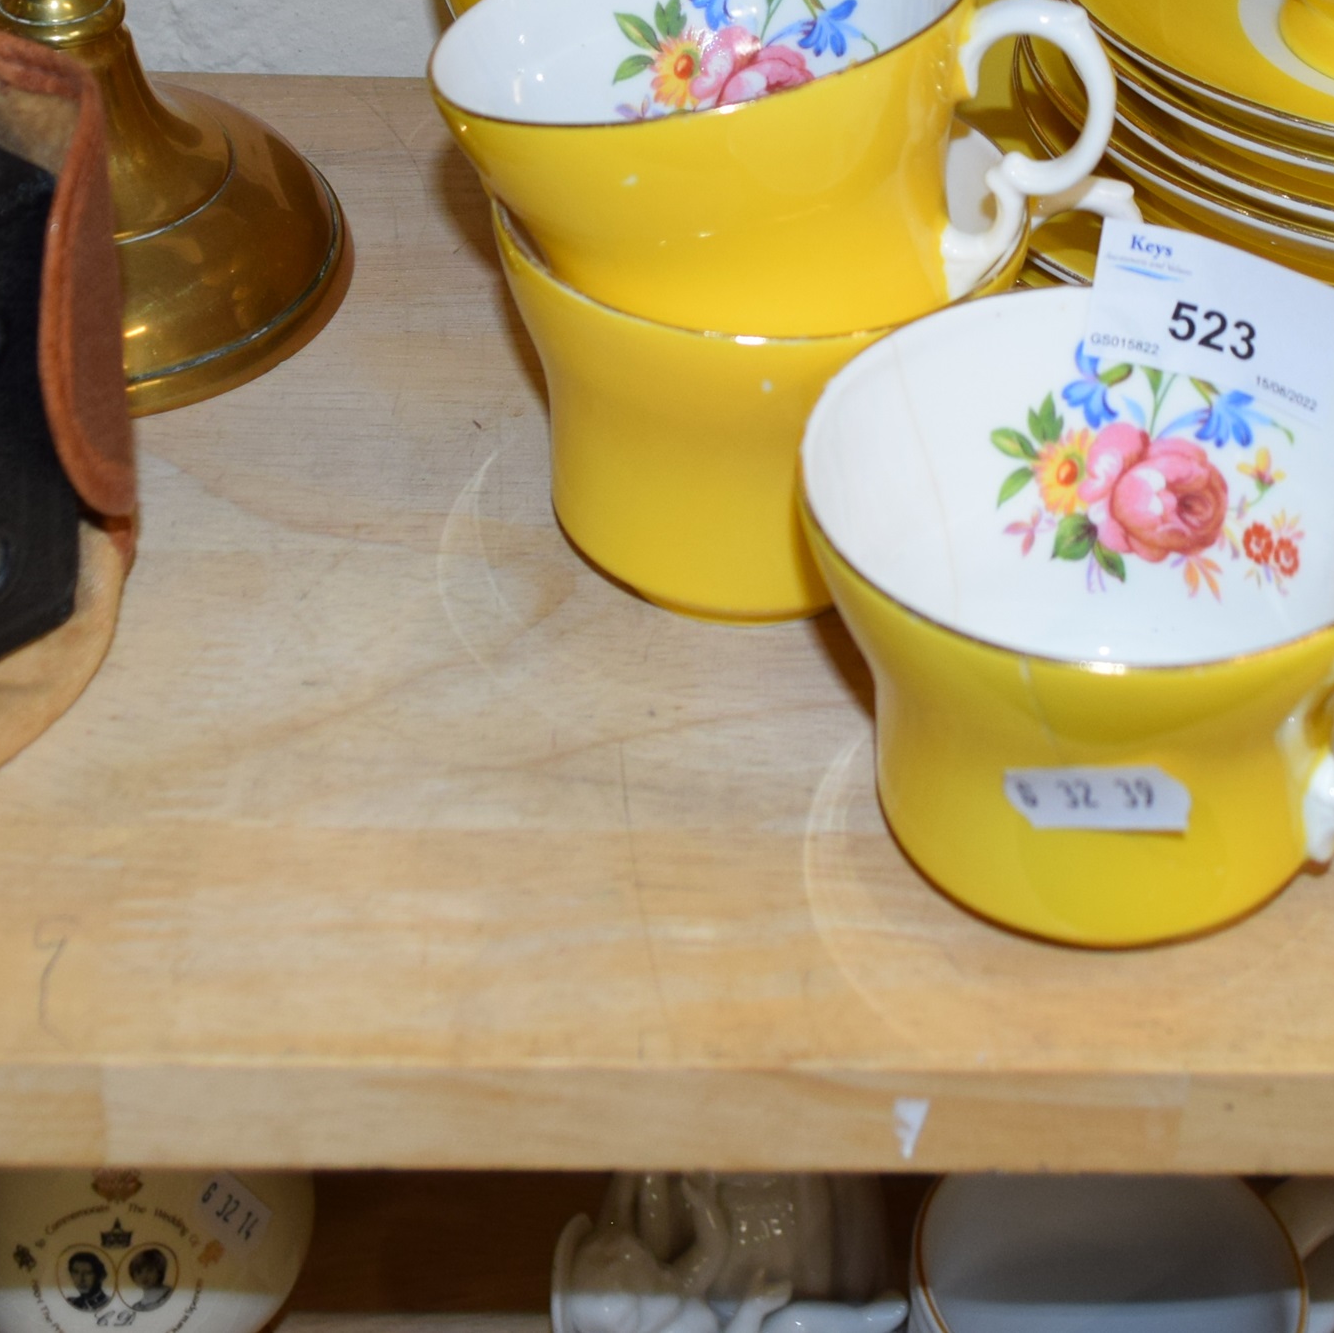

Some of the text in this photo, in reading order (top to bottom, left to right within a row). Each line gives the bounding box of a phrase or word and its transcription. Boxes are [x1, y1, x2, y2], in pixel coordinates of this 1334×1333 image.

[1130, 234, 1174, 259] Keys
[1090, 332, 1161, 356] GS015822
[1168, 301, 1258, 361] 523
[1255, 375, 1319, 413] 15/08/2022
[1056, 778, 1100, 810] 32
[1114, 777, 1155, 809] 39
[201, 1182, 259, 1241] 6 32 14
